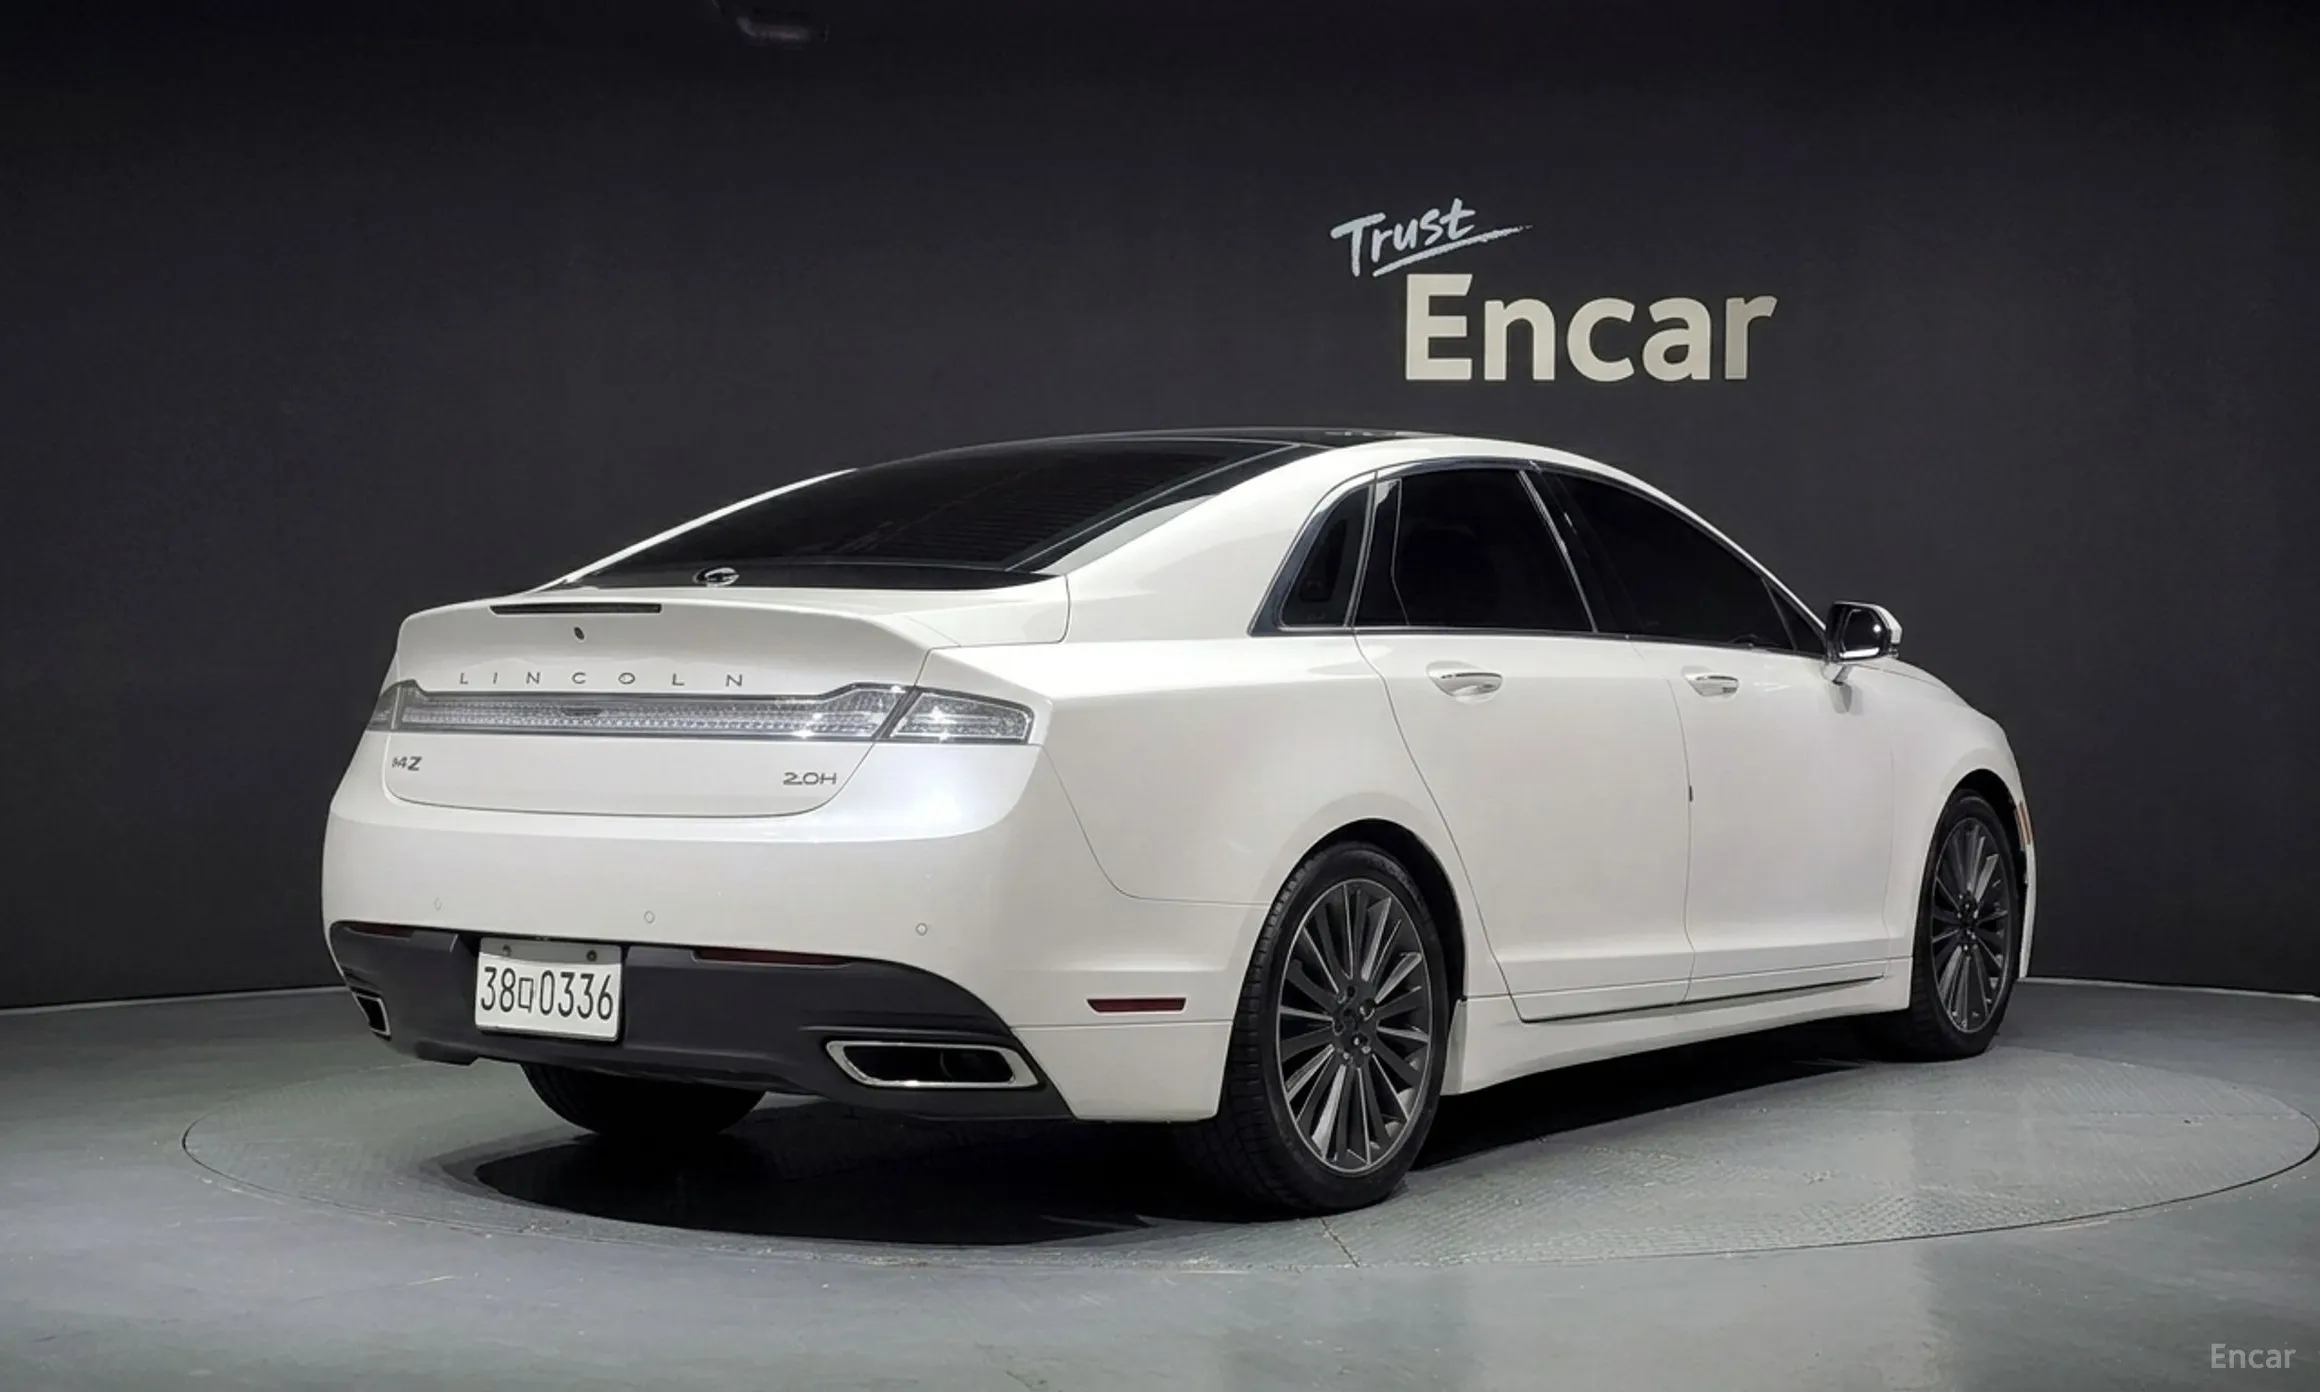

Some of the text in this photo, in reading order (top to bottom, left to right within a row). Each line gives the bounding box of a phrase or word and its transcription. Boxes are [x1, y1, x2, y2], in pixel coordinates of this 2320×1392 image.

[1330, 198, 1477, 277] Trust
[1405, 273, 1778, 382] Encar
[459, 672, 743, 688] LINCOLN
